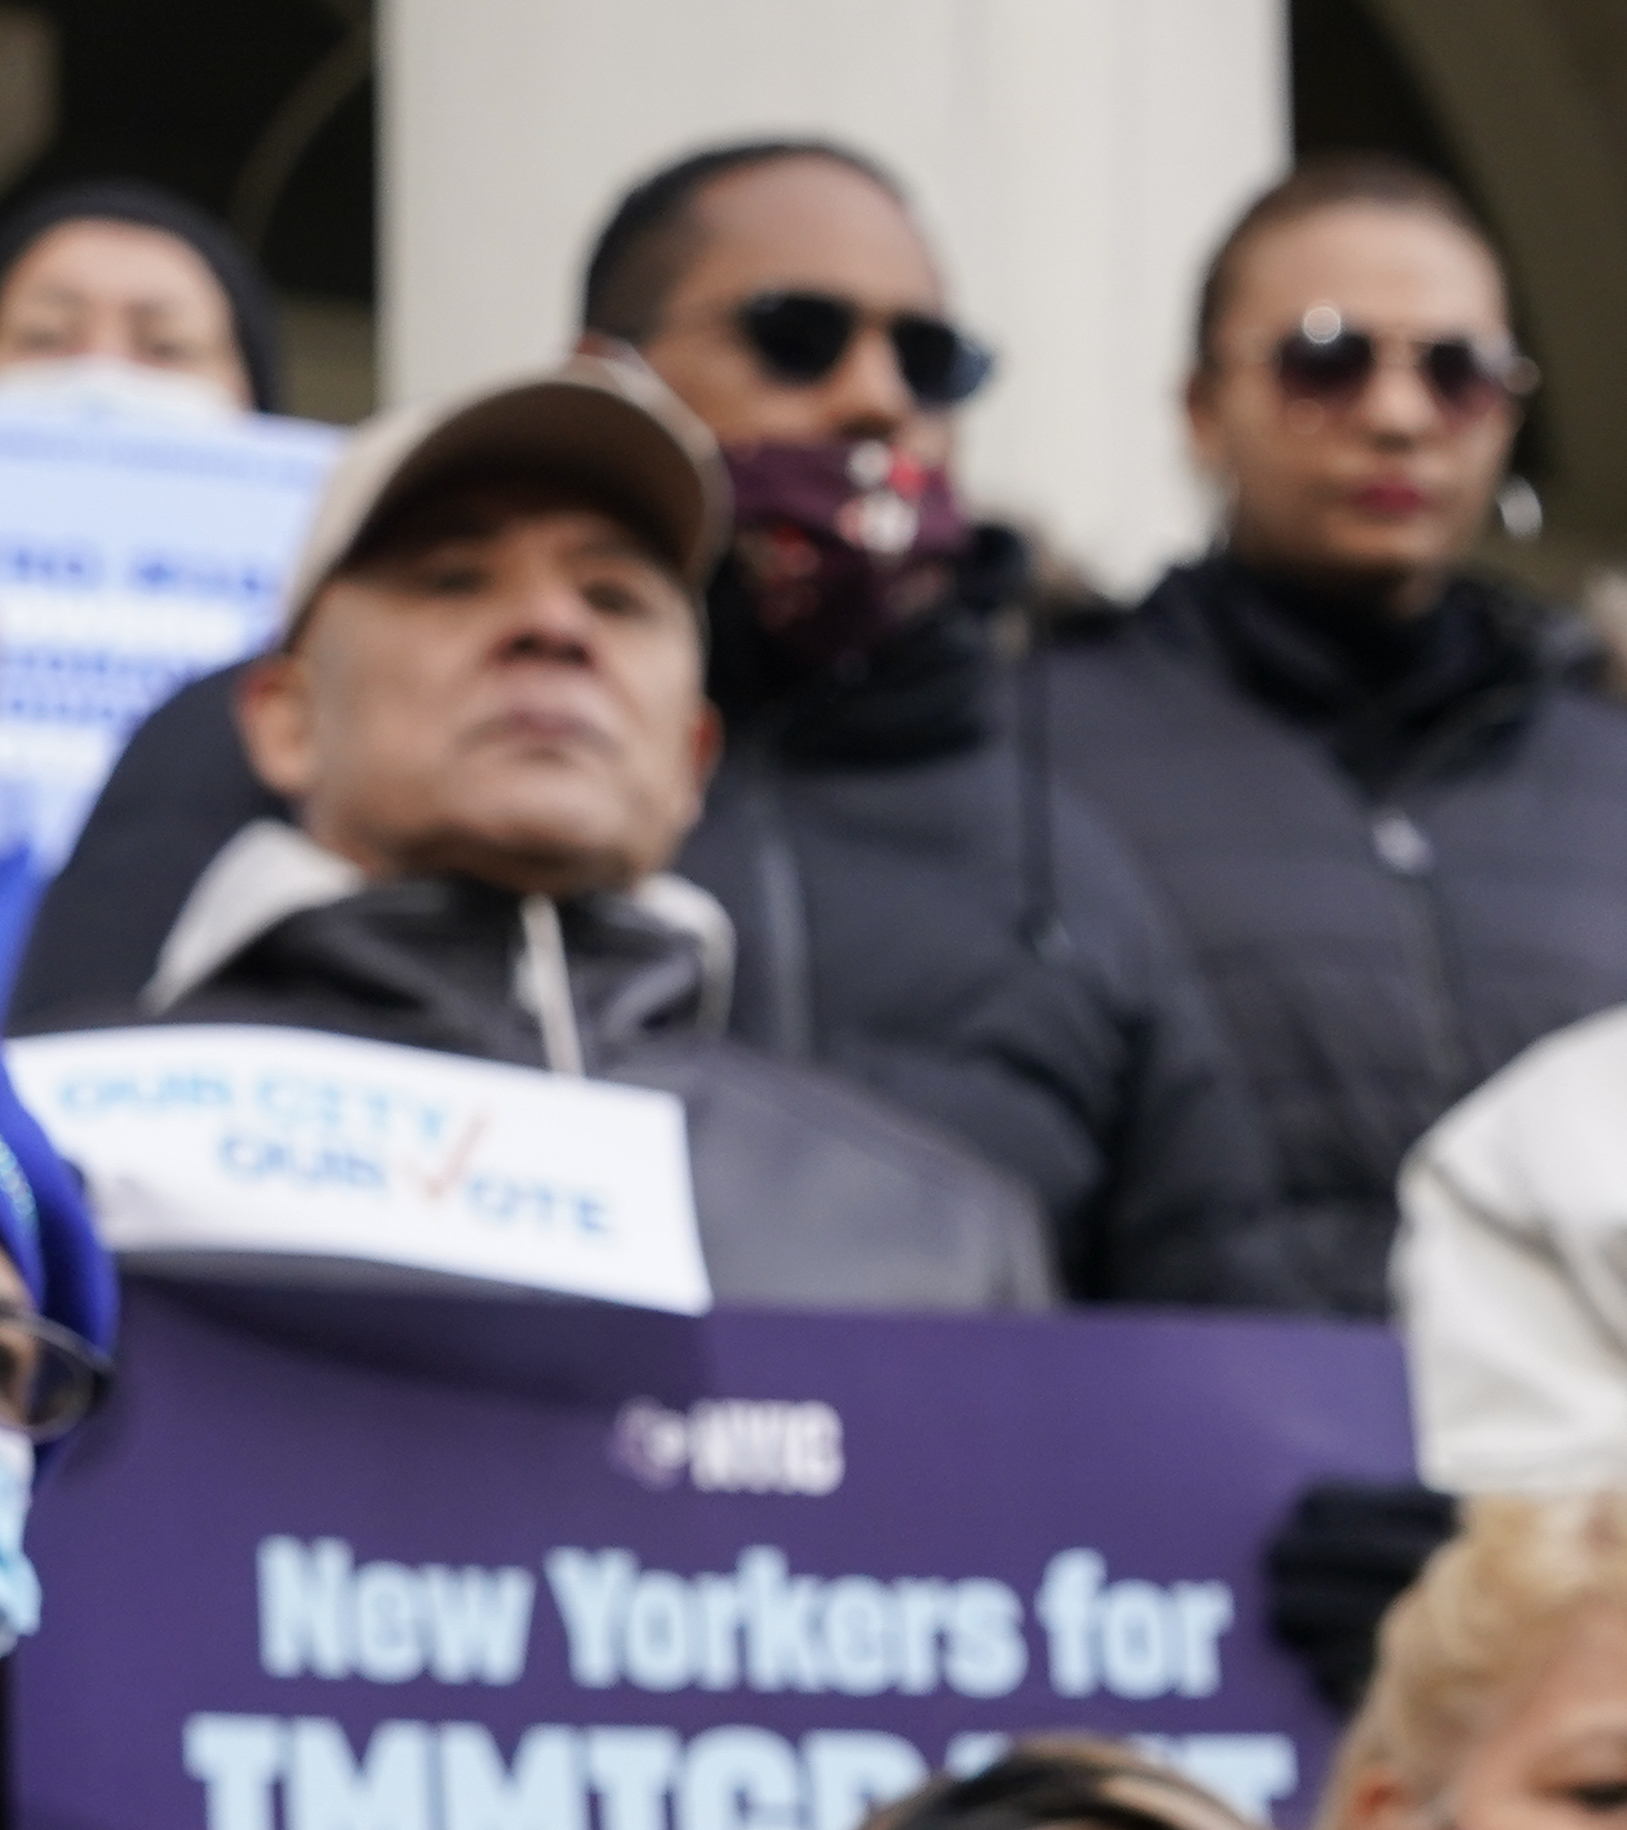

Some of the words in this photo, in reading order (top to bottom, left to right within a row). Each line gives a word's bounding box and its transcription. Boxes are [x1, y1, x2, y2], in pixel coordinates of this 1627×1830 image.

[59, 1074, 232, 1112] OUR
[257, 1078, 452, 1138] CITY
[218, 1136, 386, 1188] OUR
[256, 1534, 533, 1686] New
[546, 1545, 1027, 1698] Yorkers
[1037, 1548, 1234, 1698] for
